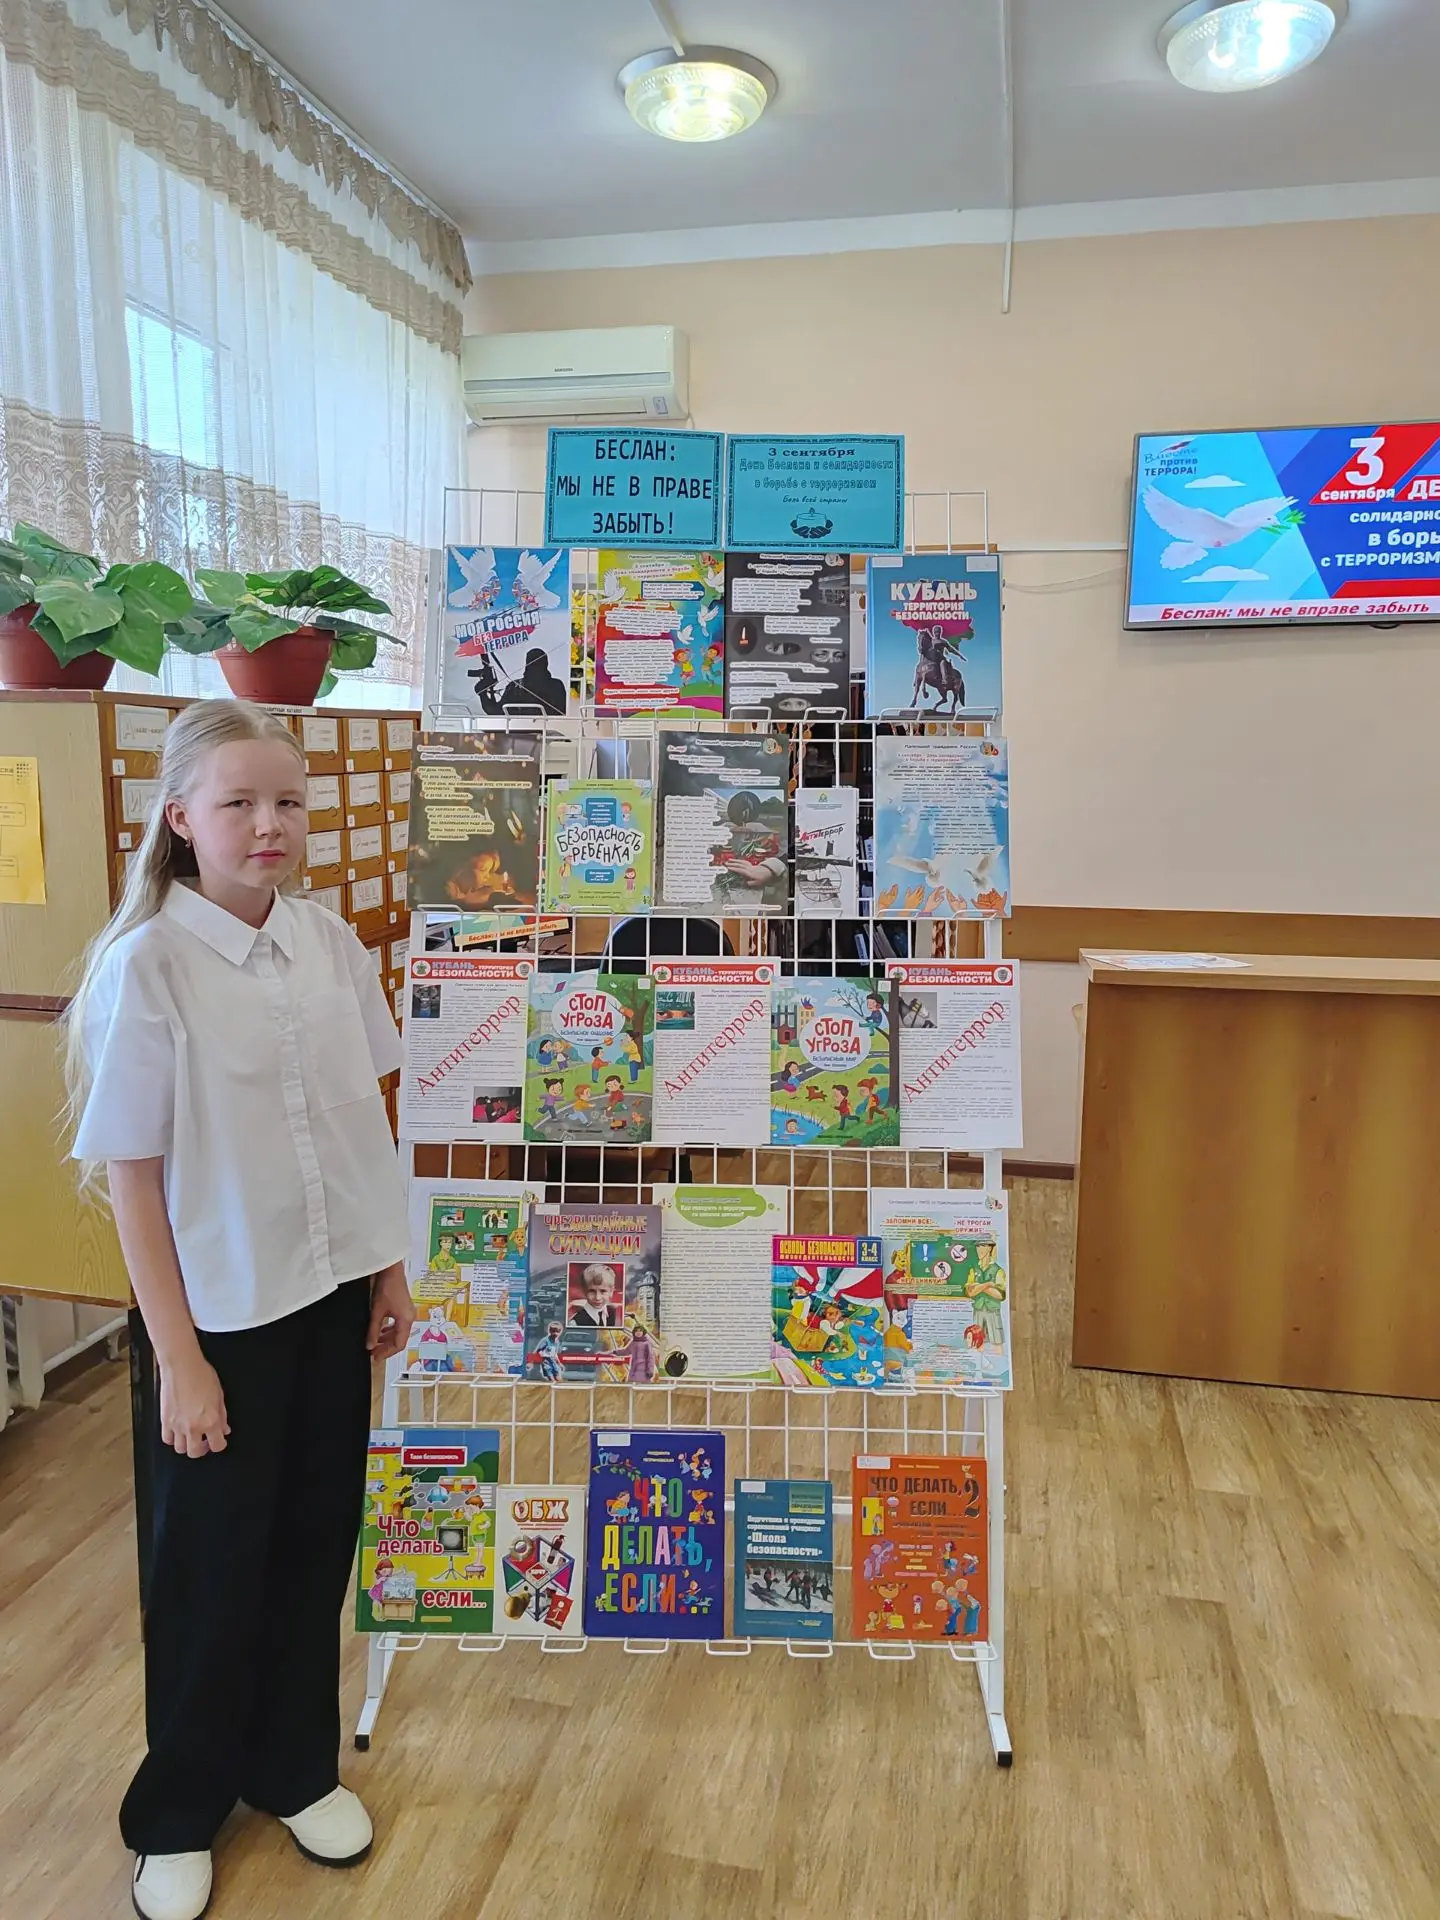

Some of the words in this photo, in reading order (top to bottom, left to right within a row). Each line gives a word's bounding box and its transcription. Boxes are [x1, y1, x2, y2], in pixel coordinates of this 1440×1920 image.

[595, 439, 676, 461] БЕСЛАН:
[768, 447, 777, 457] 3
[783, 447, 855, 458] сентября
[739, 458, 765, 471] День
[822, 459, 894, 471] солидарности
[1160, 458, 1198, 467] против
[1345, 437, 1385, 486] 3
[1144, 466, 1197, 477] ТЕРРОРА!
[556, 476, 580, 497] МЫ
[592, 476, 615, 497] НЕ
[629, 476, 640, 496] В
[653, 477, 712, 499] ПРАВЕ
[763, 477, 798, 491] борьбе
[810, 478, 877, 491] терроризмом
[1320, 487, 1395, 502] сентября
[592, 512, 673, 534] ЗАБЫТЬ!
[1368, 533, 1381, 546] в
[1320, 557, 1330, 567] с
[890, 582, 977, 600] КУБАНЬ
[903, 602, 965, 611] ТЕРРИТОРИЯ
[1160, 606, 1232, 620] Беслан:
[1238, 606, 1265, 617] мы
[1271, 606, 1293, 616] не
[1297, 604, 1359, 617] вправе
[1366, 602, 1430, 614] забыть
[455, 619, 484, 639] МОЯ
[487, 610, 541, 633] РОССИЯ
[895, 611, 970, 621] БЕЗОПАСНОСТИ
[473, 631, 493, 646] БЕЗ
[484, 630, 529, 653] ТЕРРОРА
[556, 826, 642, 852] БЕЗОПАСНОСТЬ
[572, 843, 630, 863] РЕБЕНКА
[908, 968, 952, 976] КУБАНЬ
[908, 976, 992, 984] БЕЗОПАСНОСТИ
[568, 994, 606, 1012] СТОП
[560, 1012, 614, 1030] УГРОЗА
[814, 1018, 854, 1037] СТОП
[416, 995, 521, 1097] Антитеррор
[664, 999, 765, 1100] Антитеррор
[806, 1036, 861, 1055] УГРОЗА
[903, 1001, 1006, 1103] Антитеррор
[549, 1234, 641, 1258] СИТУАЦИИ
[808, 1240, 855, 1256] БЕЗОПАСНОСТИ
[862, 1242, 878, 1257] 3-4
[870, 1476, 898, 1493] ЧТО
[634, 1477, 683, 1518] ЧТО
[514, 1500, 568, 1522] ОБЖ
[378, 1516, 420, 1538] Что
[378, 1540, 444, 1556] делать
[601, 1526, 712, 1572] ДЕЛАТЬ,
[746, 1544, 822, 1556] безопасности»
[423, 1590, 487, 1608] если...
